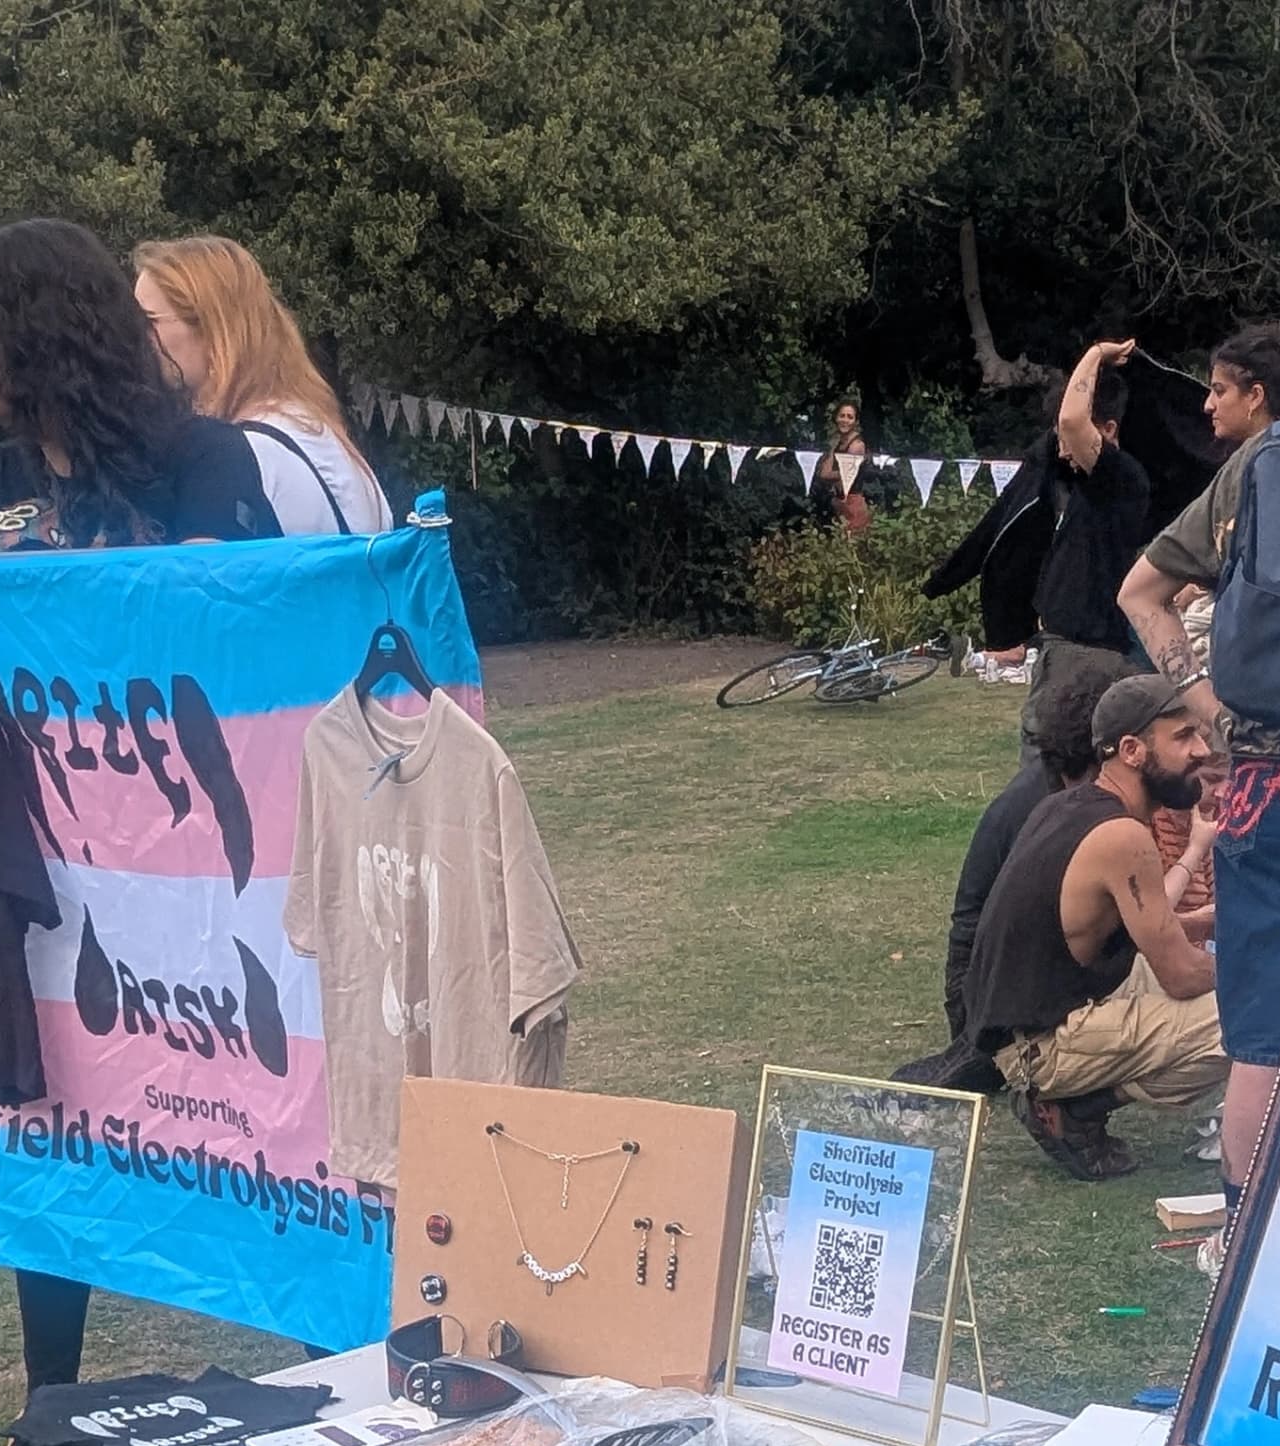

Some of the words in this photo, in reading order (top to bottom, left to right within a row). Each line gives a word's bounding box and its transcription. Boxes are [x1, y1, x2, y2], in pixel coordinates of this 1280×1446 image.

[144, 1084, 254, 1139] Supporting
[823, 1141, 896, 1169] Sheffield
[100, 1113, 349, 1236] Electrolysis
[809, 1163, 904, 1197] Electrolysis
[823, 1189, 881, 1218] Project
[780, 1313, 864, 1350] REGISTER
[866, 1333, 891, 1356] AS
[792, 1343, 805, 1363] A
[807, 1346, 870, 1378] CLIENT
